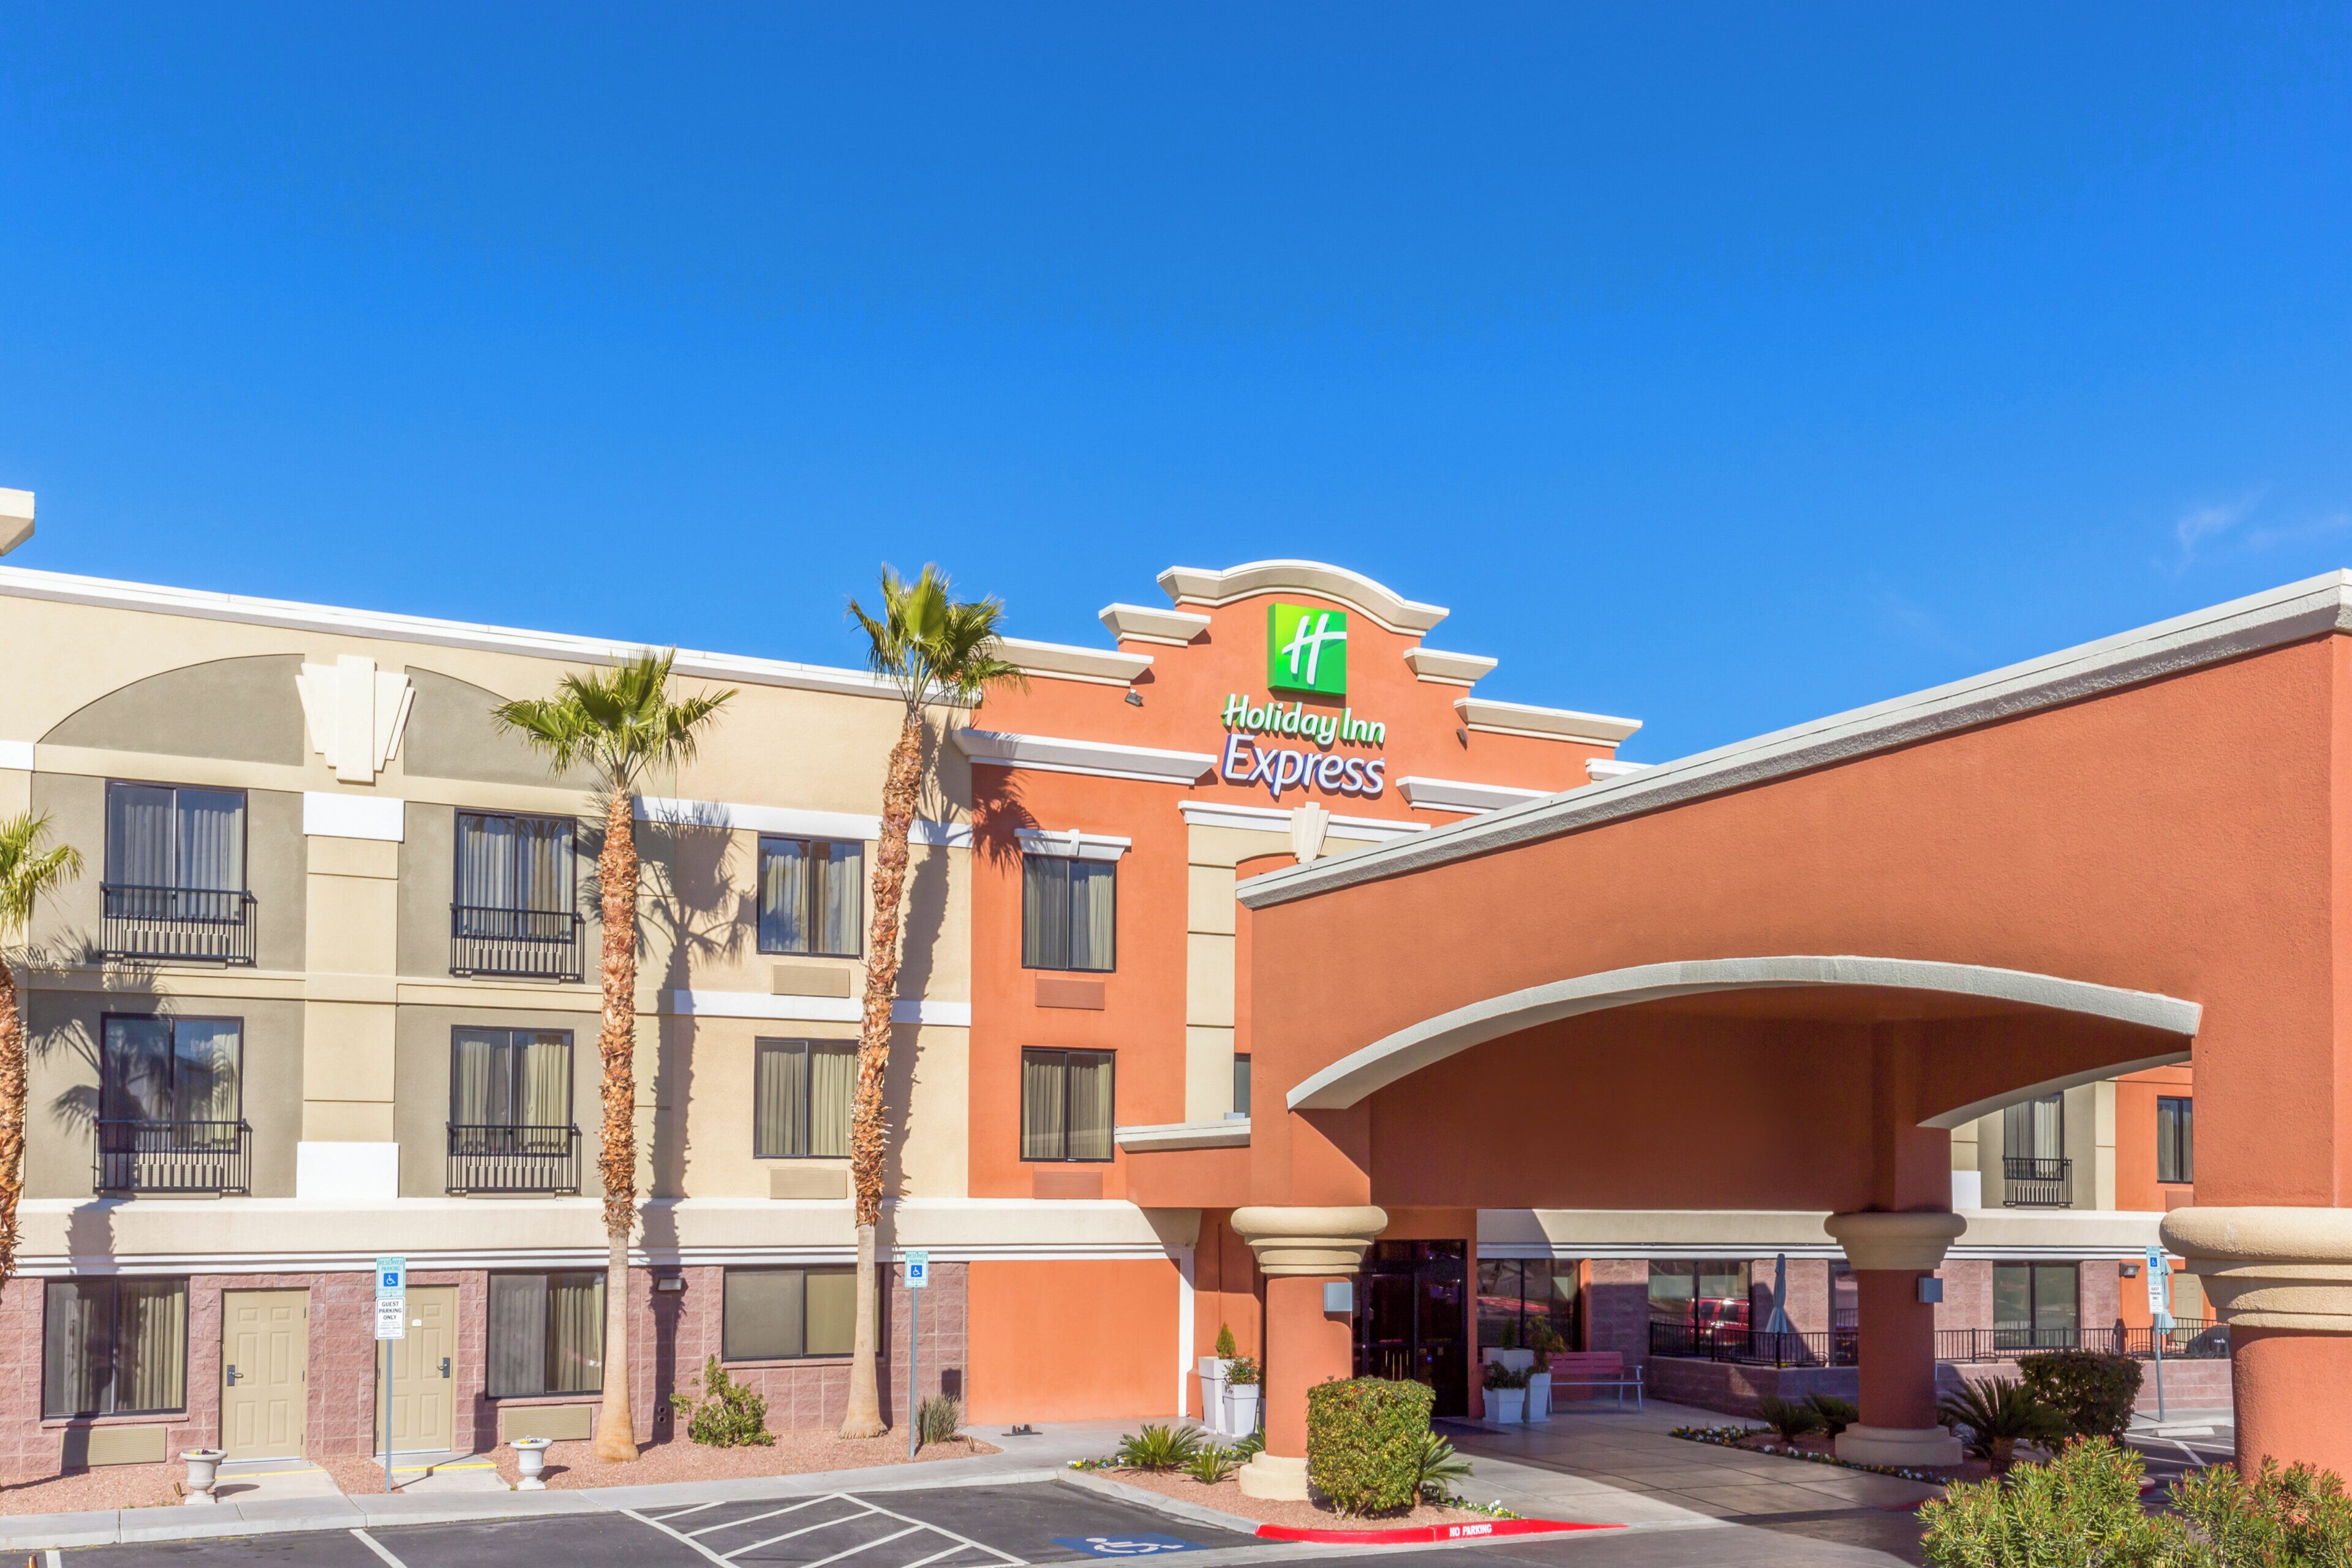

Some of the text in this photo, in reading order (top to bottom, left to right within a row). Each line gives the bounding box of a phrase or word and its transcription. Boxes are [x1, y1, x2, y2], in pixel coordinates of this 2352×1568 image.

[1222, 693, 1386, 745] Holiday Inn
[1221, 733, 1385, 797] Express
[1450, 1524, 1492, 1537] NO PARKING
